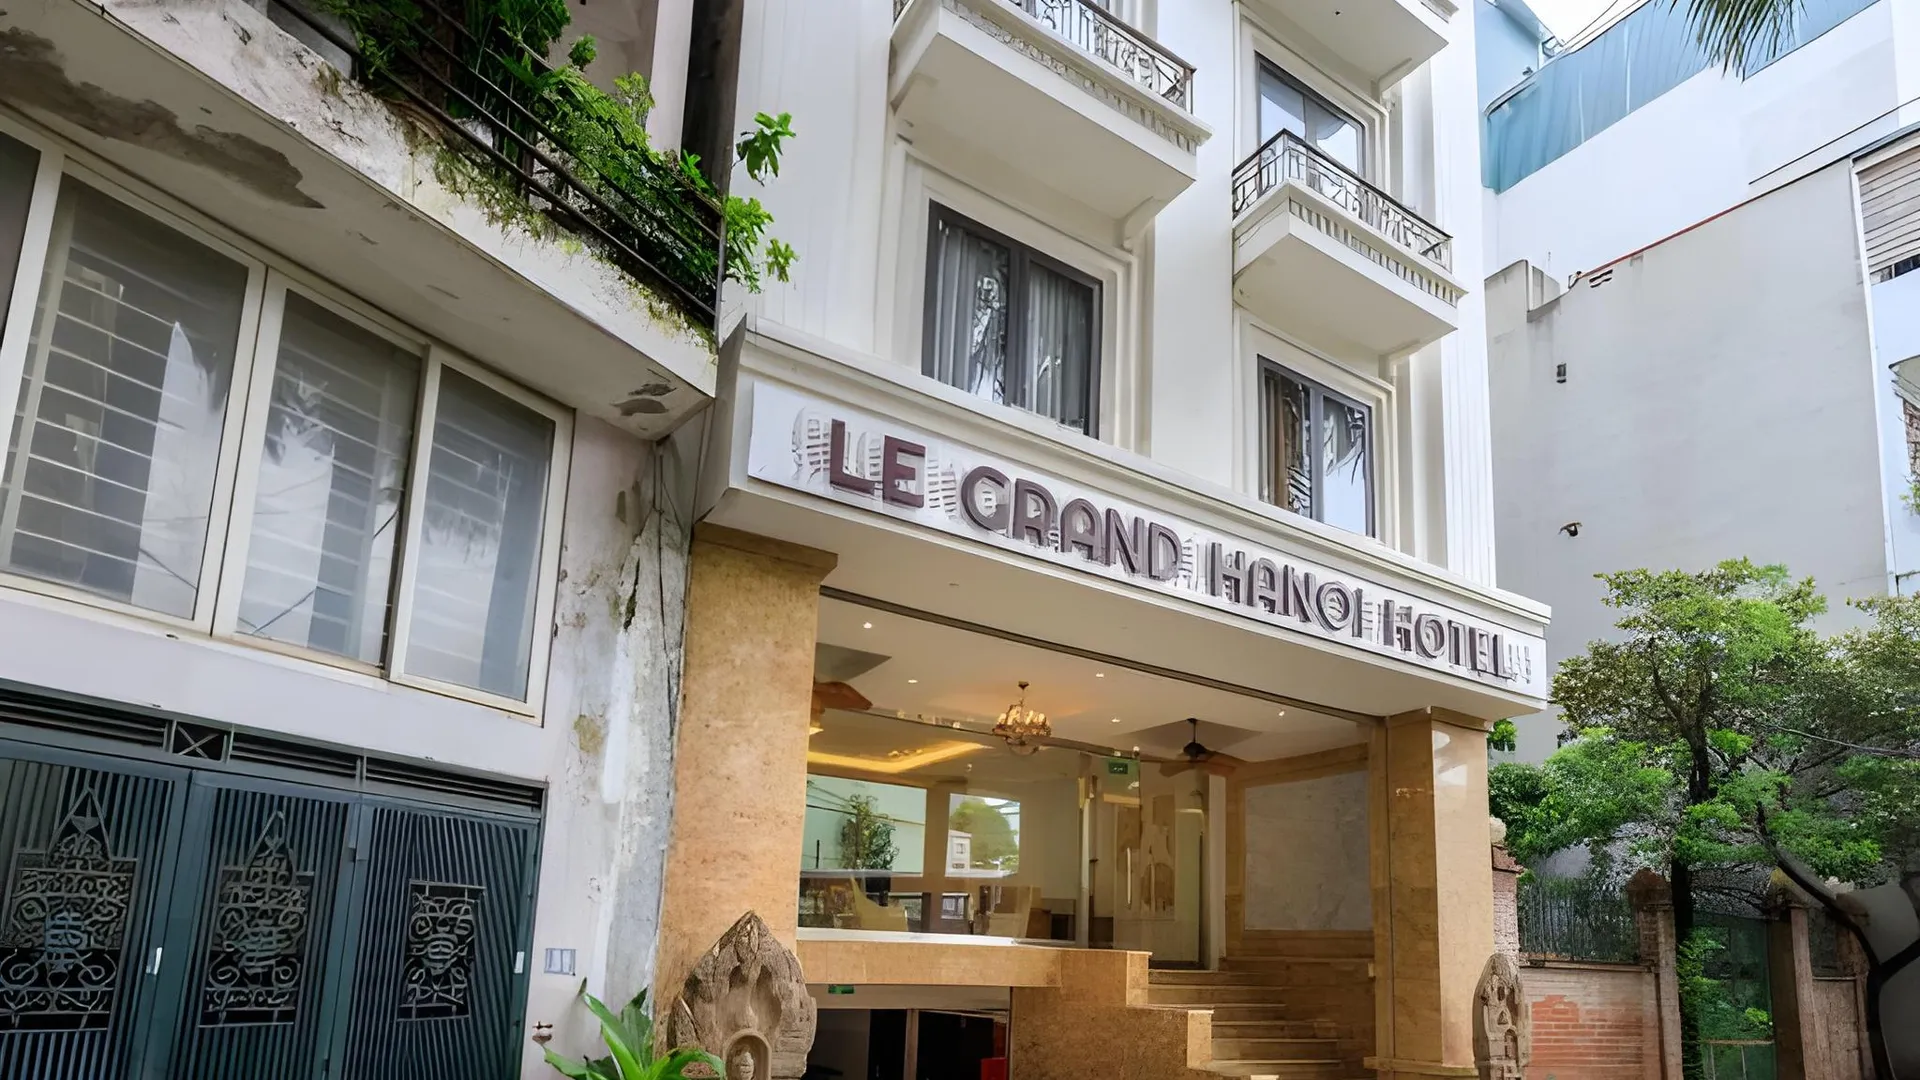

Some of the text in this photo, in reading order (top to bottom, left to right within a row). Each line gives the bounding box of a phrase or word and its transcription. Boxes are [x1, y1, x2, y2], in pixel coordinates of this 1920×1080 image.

[829, 418, 1514, 679] LE GRAND HANOI HOTEL
